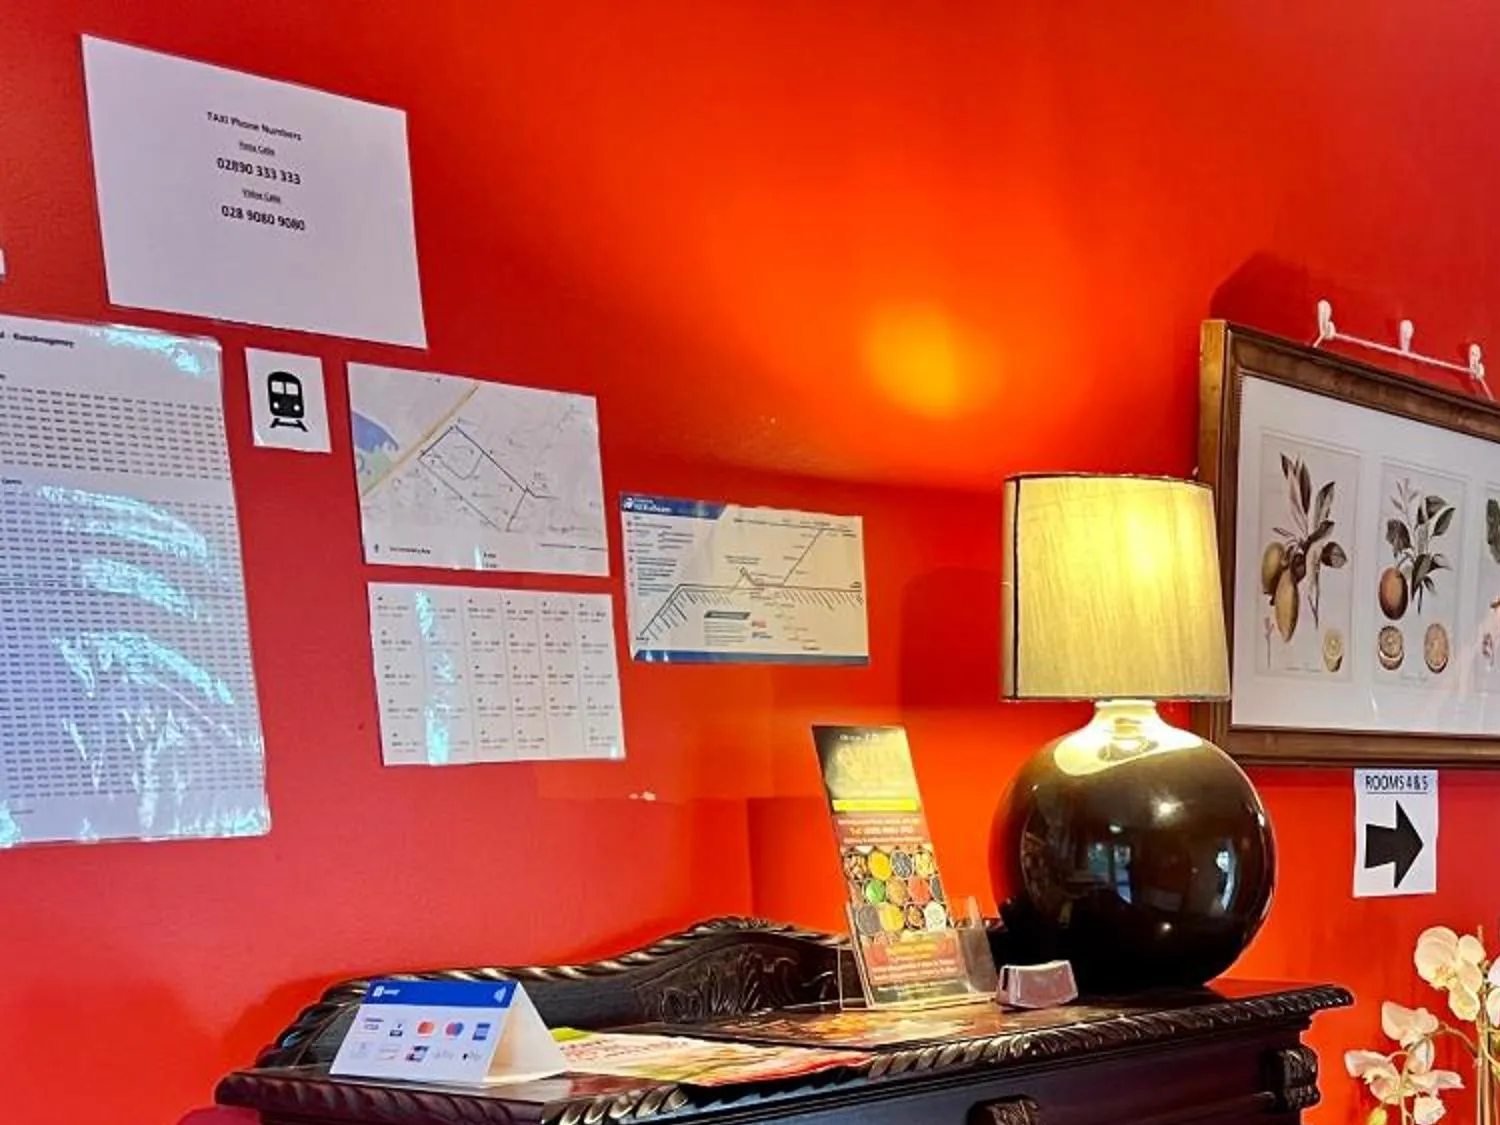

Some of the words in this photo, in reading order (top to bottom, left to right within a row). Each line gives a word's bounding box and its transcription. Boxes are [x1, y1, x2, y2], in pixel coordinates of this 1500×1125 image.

[207, 111, 229, 123] TAXI
[230, 117, 260, 130] Phone
[261, 124, 302, 140] Numbers
[255, 165, 277, 181] 333
[280, 169, 301, 185] 333
[221, 204, 243, 219] 028
[1366, 775, 1404, 790] ROOMS
[1406, 775, 1412, 789] 4
[1422, 774, 1429, 790] 5
